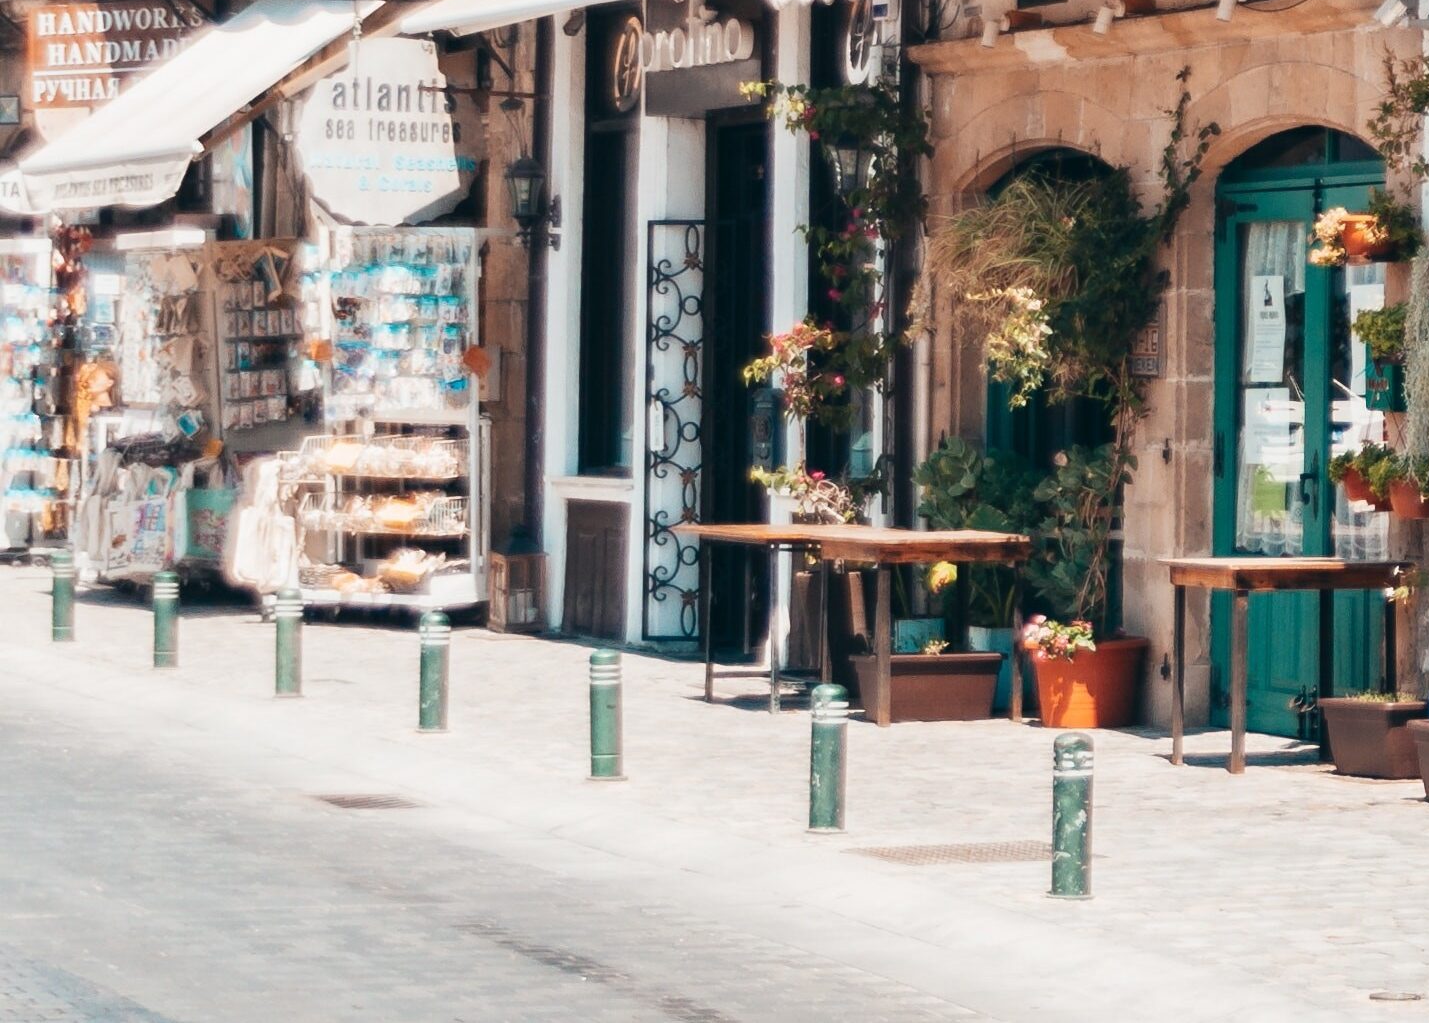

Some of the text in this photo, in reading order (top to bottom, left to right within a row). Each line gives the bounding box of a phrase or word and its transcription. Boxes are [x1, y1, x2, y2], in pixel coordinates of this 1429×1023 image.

[32, 77, 121, 103] РУЧНАЯ
[331, 77, 458, 114] atlantis
[325, 118, 462, 144] sea treasures
